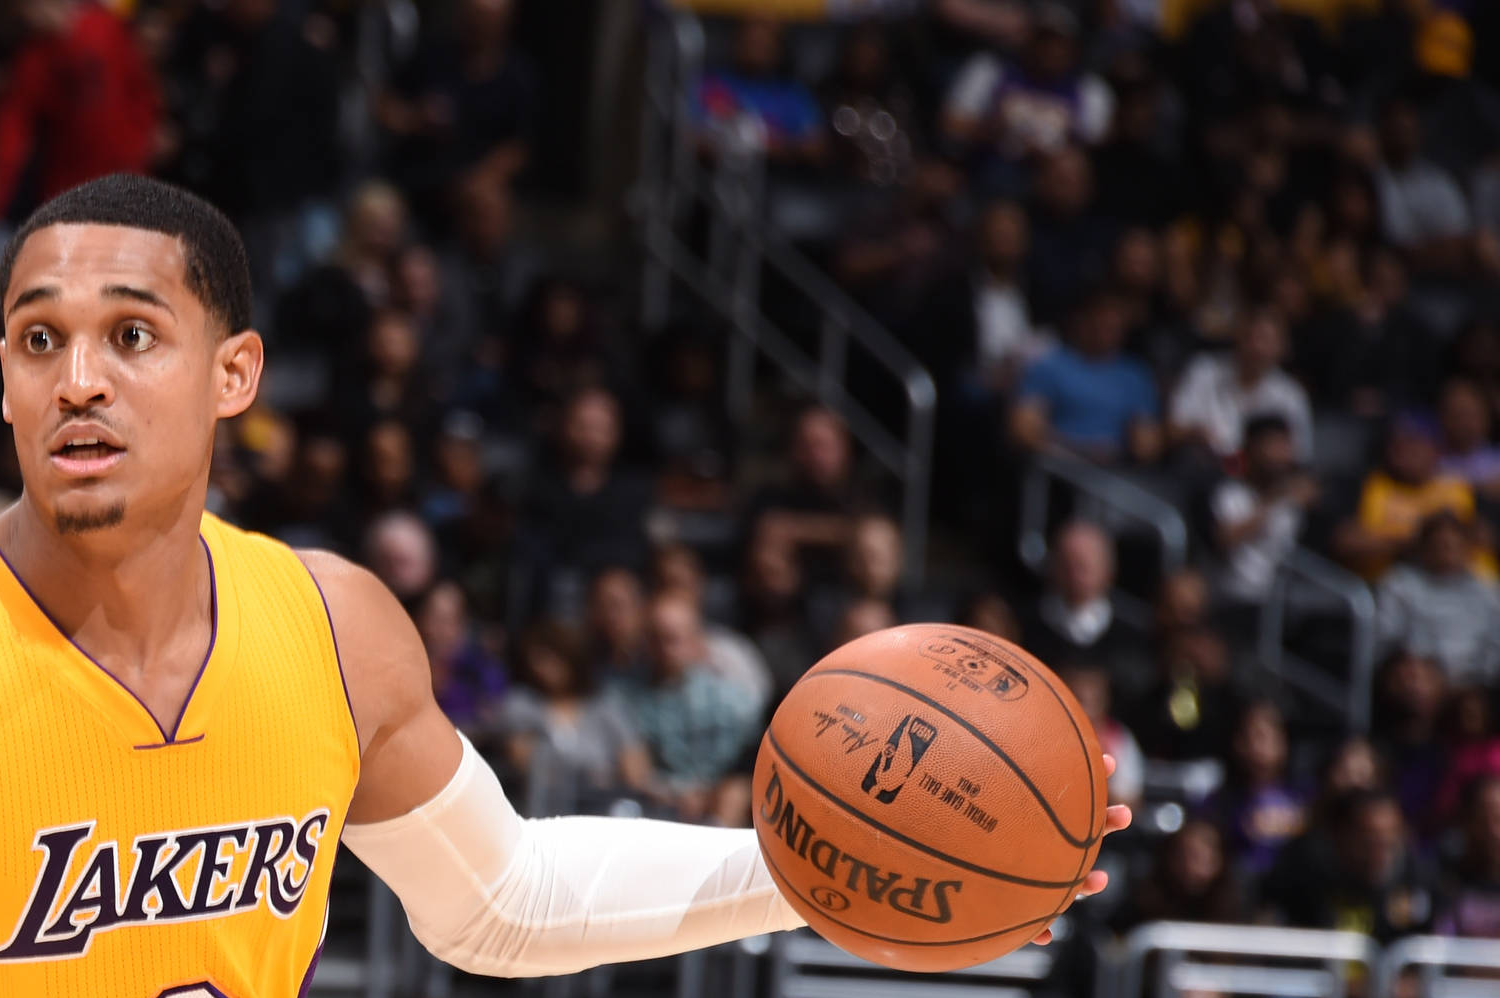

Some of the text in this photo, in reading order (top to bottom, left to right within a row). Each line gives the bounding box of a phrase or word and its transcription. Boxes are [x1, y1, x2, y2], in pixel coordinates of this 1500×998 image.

[911, 720, 935, 742] NBA
[918, 773, 998, 833] OFFICIAL GAME BALL
[761, 770, 963, 924] SPALDING
